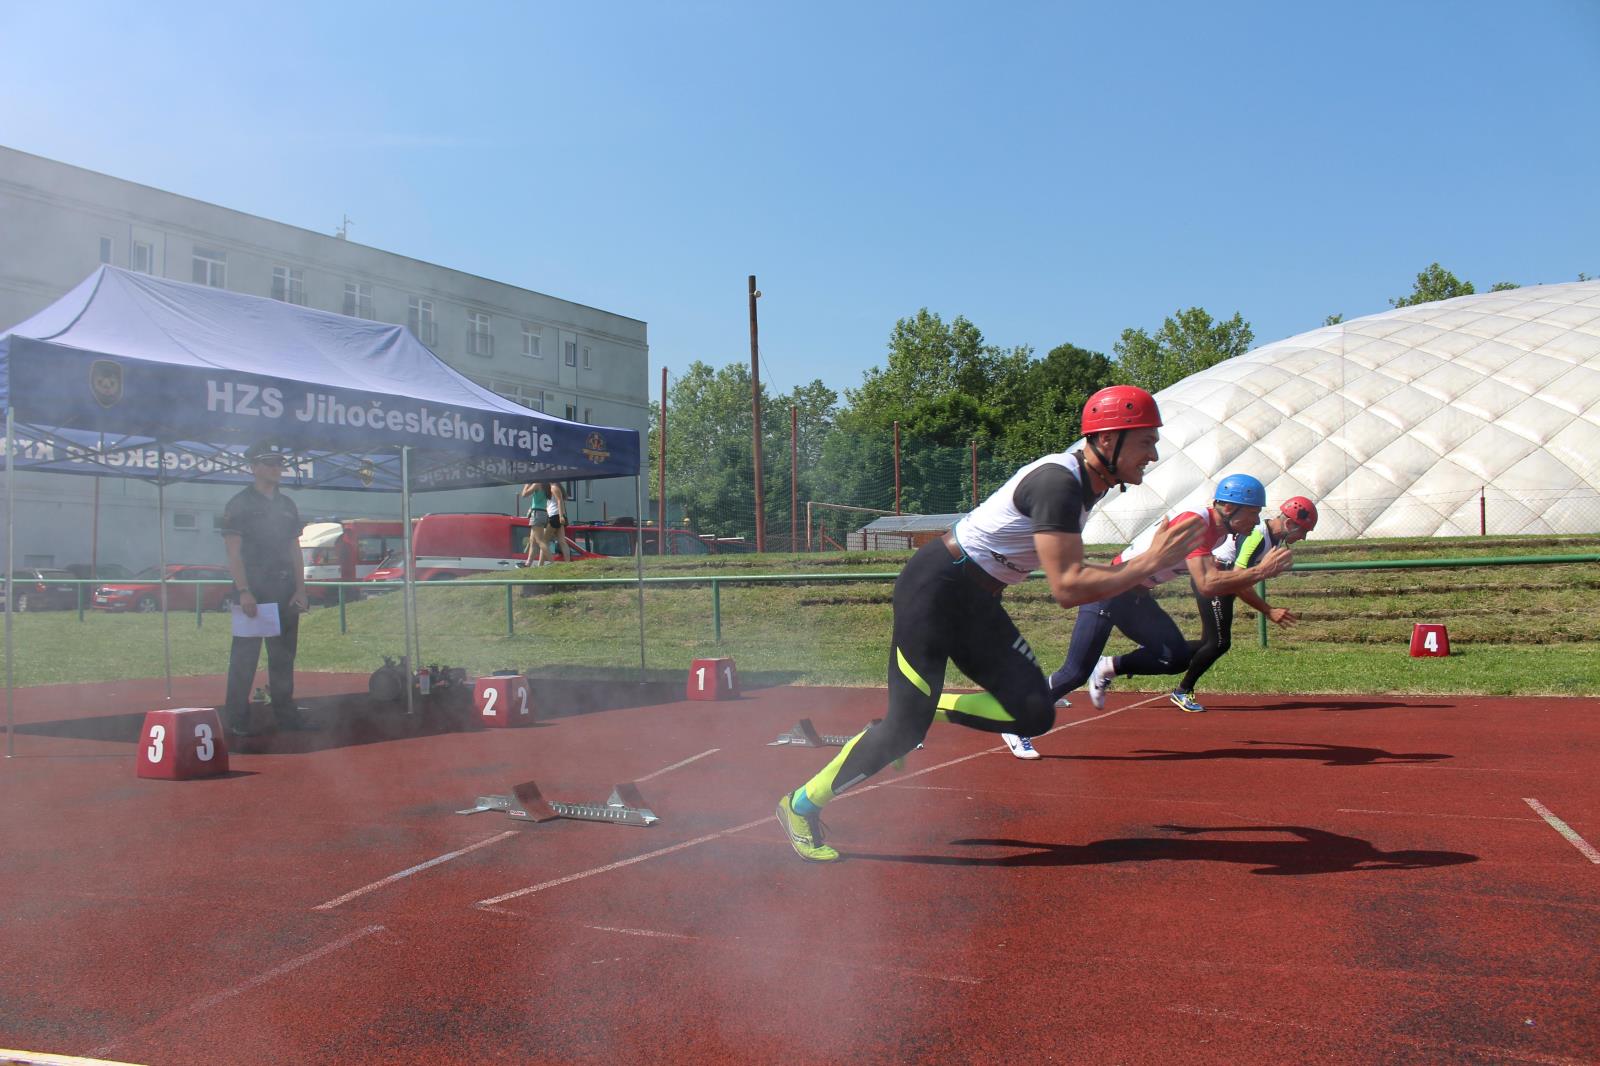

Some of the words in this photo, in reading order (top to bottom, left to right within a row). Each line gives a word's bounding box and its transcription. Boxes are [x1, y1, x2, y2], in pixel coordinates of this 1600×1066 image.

[208, 380, 284, 418] HZS
[296, 393, 485, 443] Jihočeského
[494, 420, 553, 457] kraje
[1424, 631, 1438, 653] 4
[696, 667, 705, 691] 1
[724, 666, 733, 689] 1
[483, 687, 498, 716] 2
[517, 686, 529, 715] 2
[147, 724, 166, 764] 3
[194, 723, 215, 762] 3
